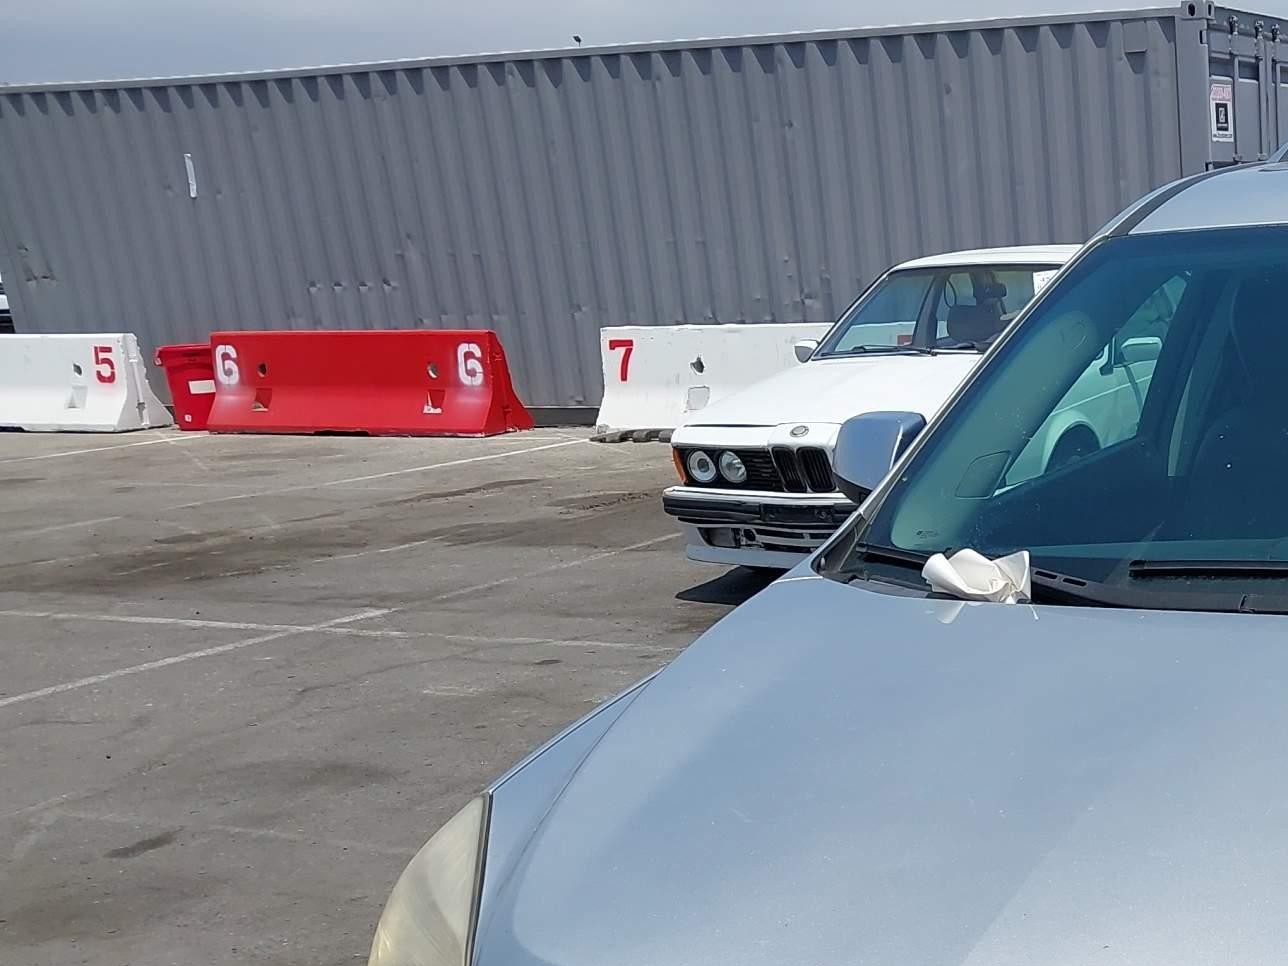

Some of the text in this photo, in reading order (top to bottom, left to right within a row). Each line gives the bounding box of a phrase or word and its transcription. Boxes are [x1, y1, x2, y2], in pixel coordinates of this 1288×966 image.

[94, 346, 116, 384] 5
[215, 344, 240, 385] 6
[457, 343, 485, 386] 6
[609, 339, 634, 382] 7
